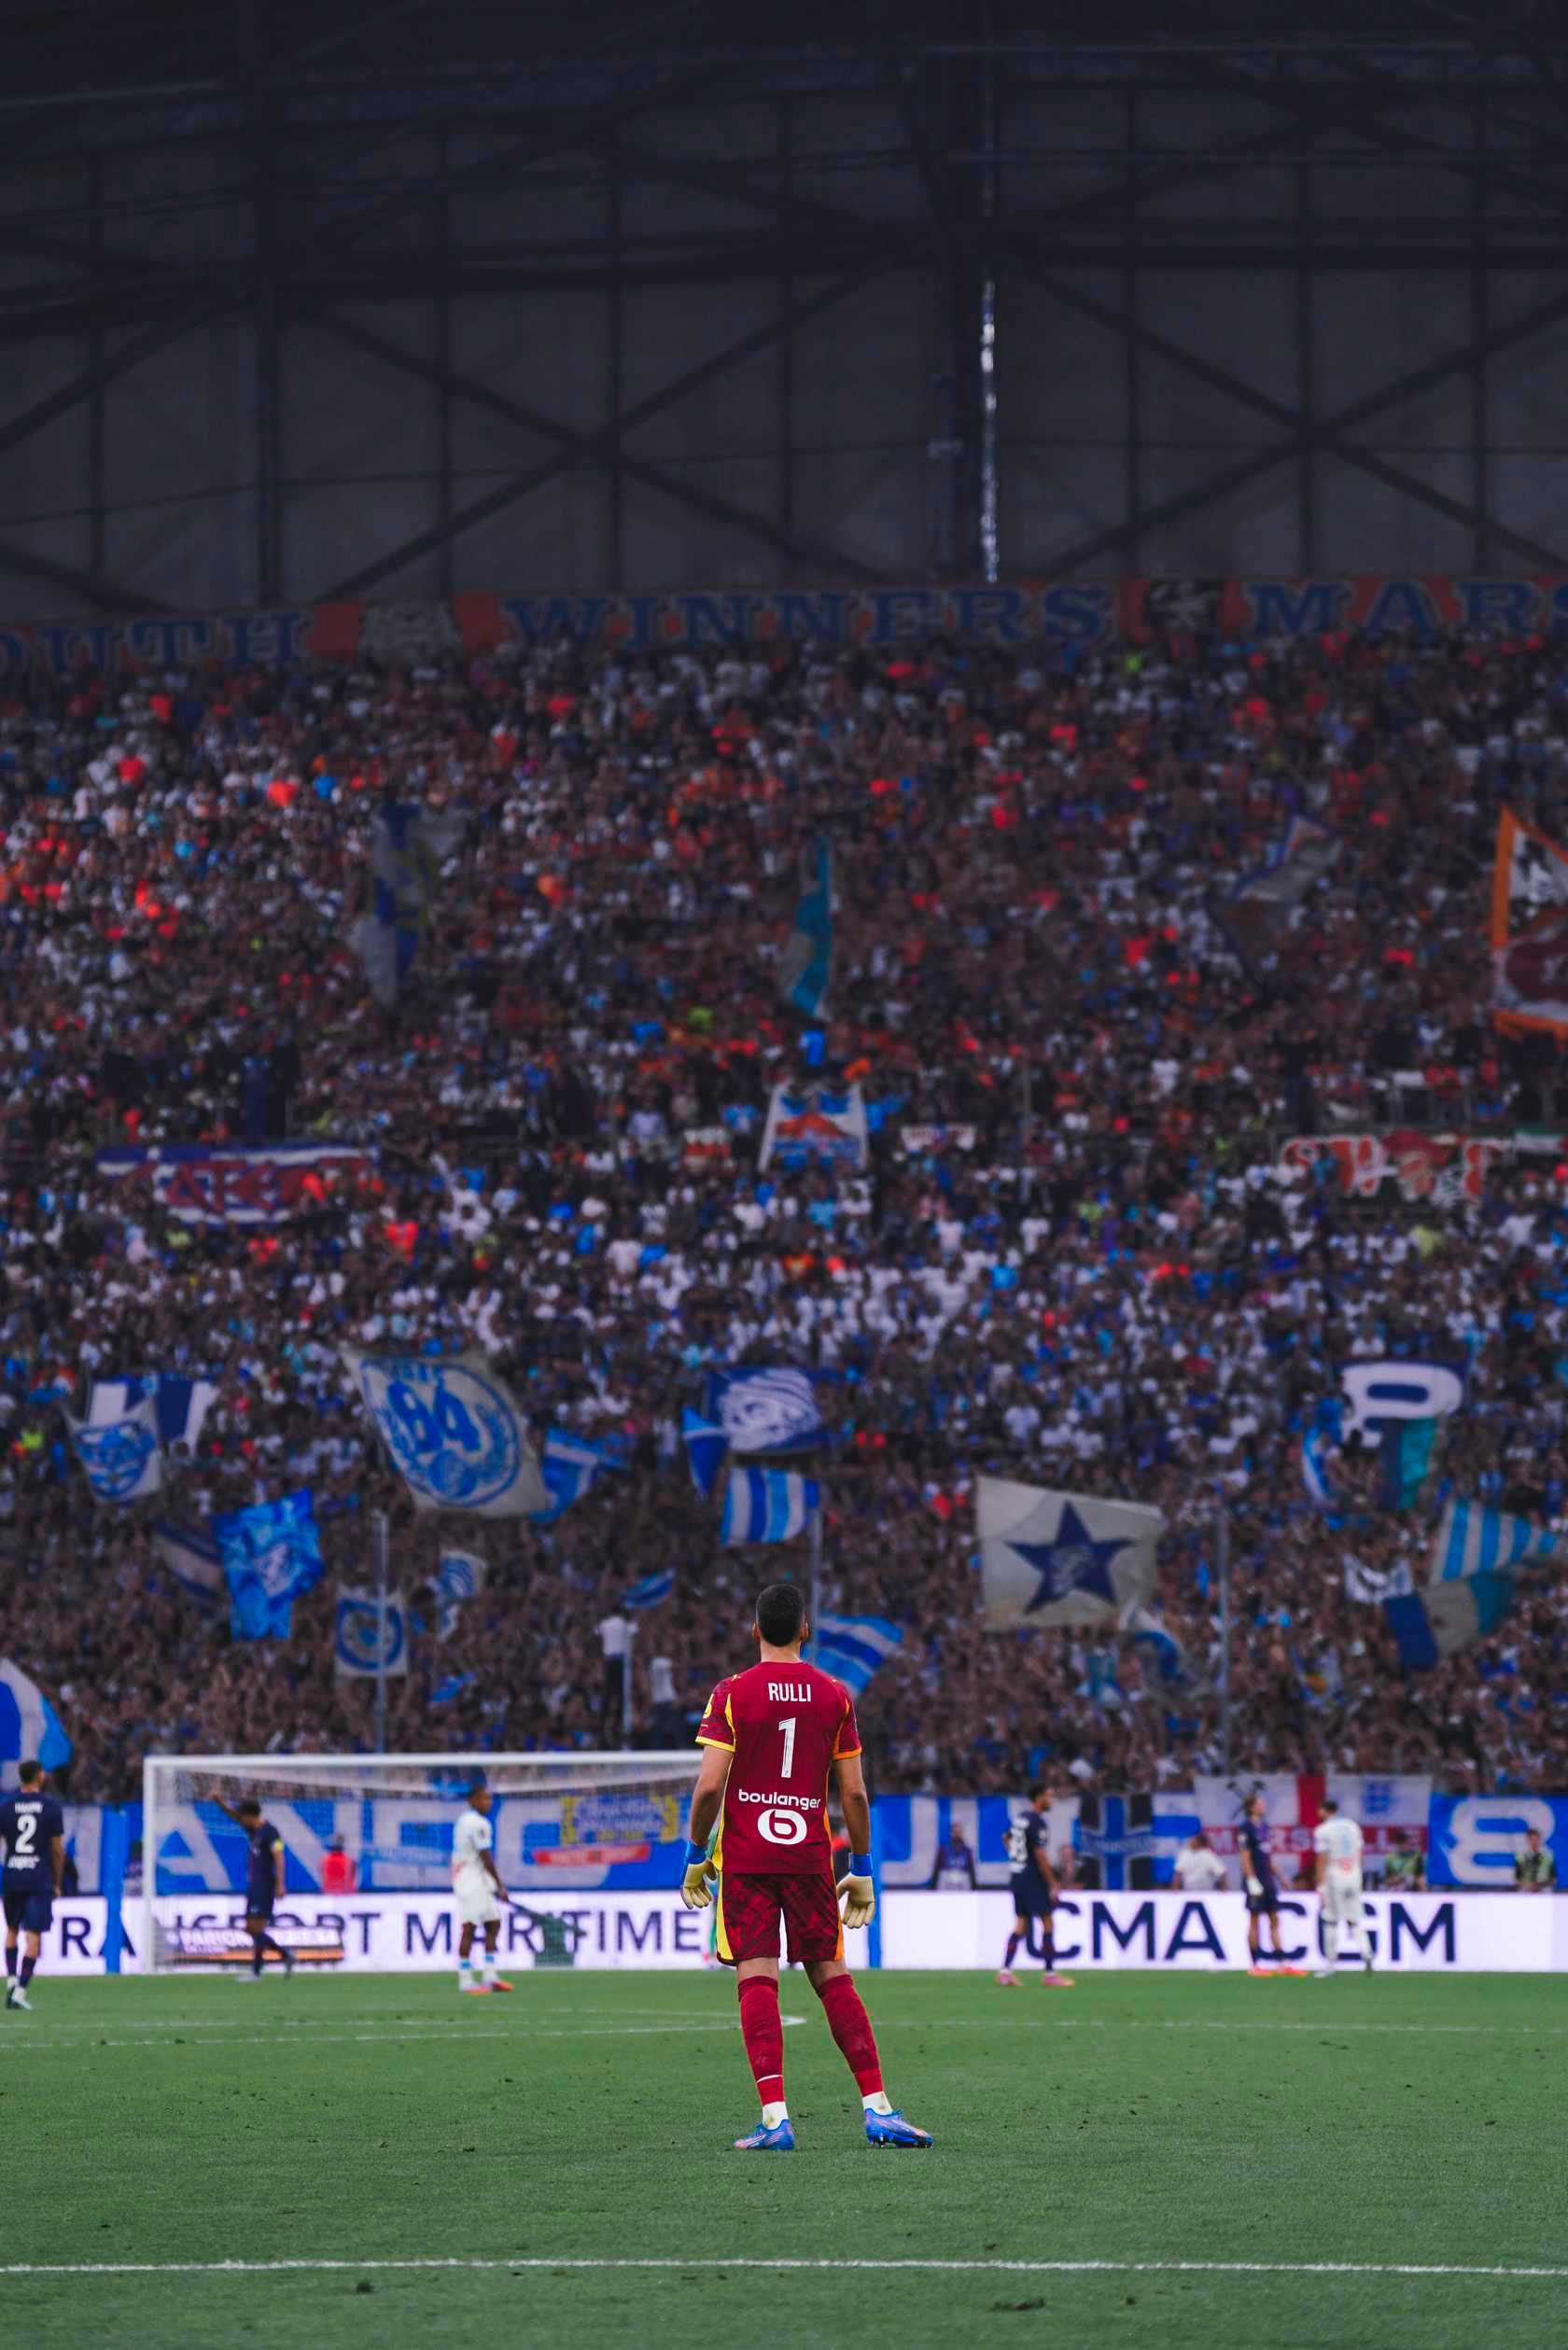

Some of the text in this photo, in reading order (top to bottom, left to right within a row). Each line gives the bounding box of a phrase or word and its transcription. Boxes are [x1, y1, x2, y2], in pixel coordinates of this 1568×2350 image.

[502, 584, 1111, 648] WINNERS
[767, 1682, 812, 1702] RULLI
[778, 1716, 796, 1779] 1
[738, 1789, 821, 1811] boulanger
[15, 1814, 37, 1853] 2
[406, 1911, 701, 1953] MRTIME
[1027, 1901, 1226, 1961] CMA
